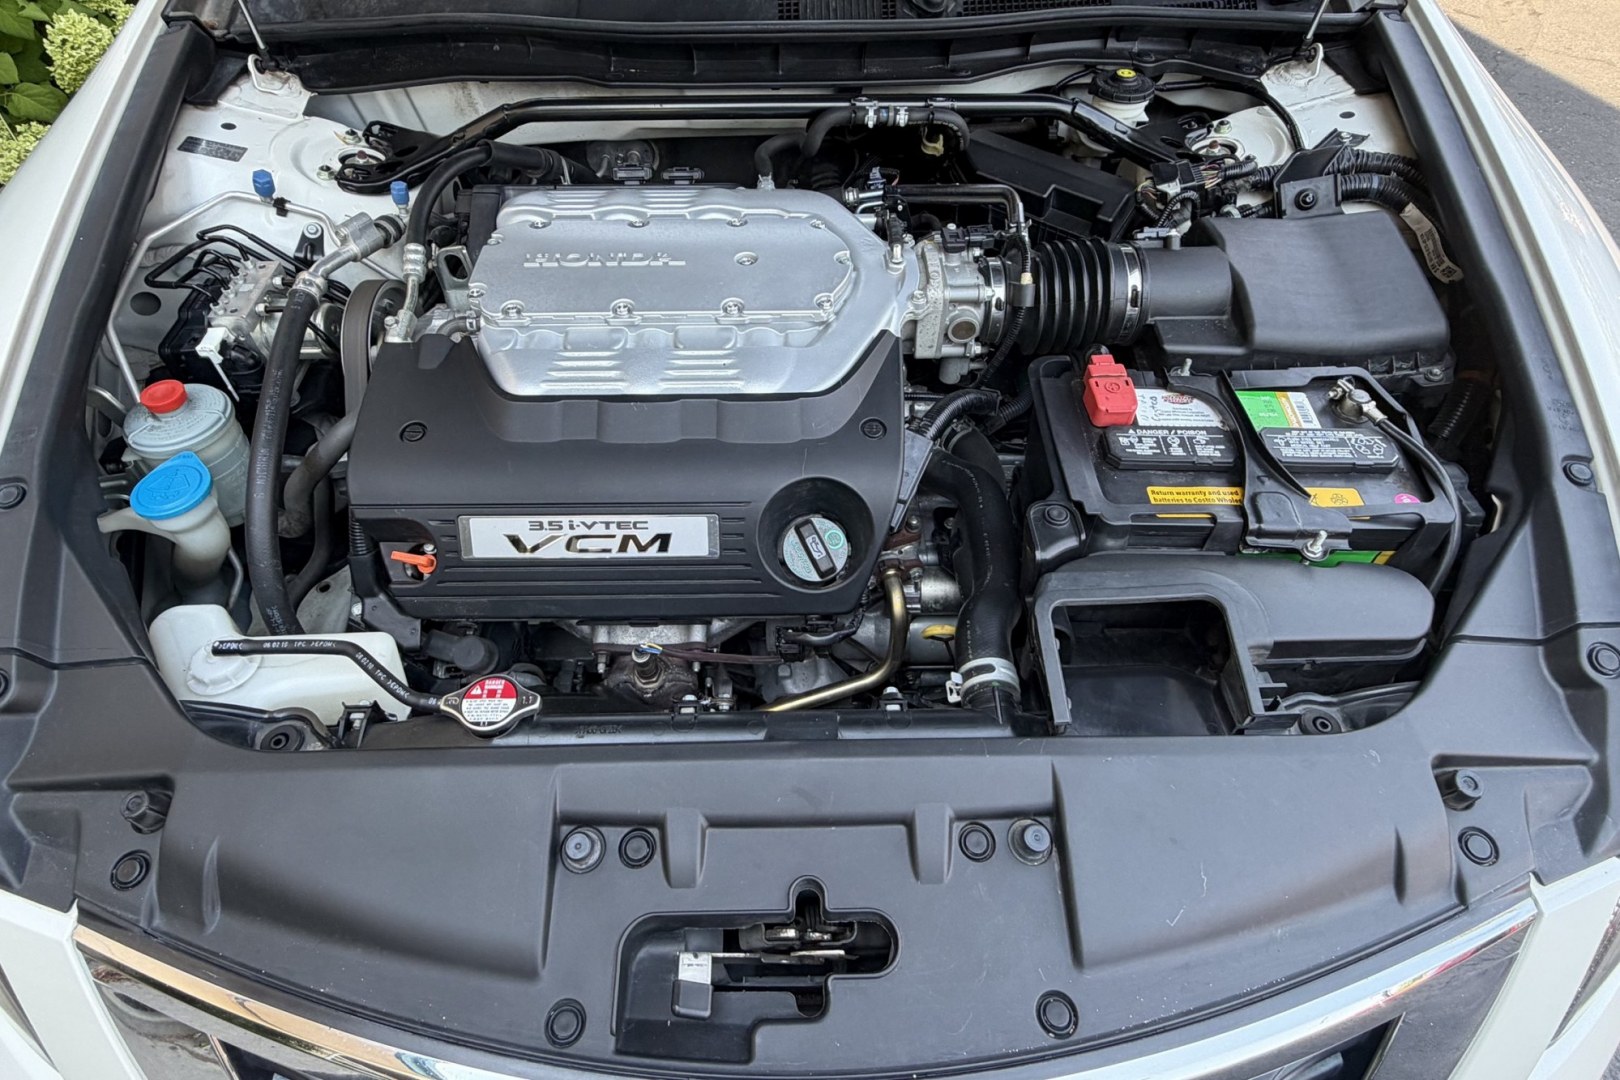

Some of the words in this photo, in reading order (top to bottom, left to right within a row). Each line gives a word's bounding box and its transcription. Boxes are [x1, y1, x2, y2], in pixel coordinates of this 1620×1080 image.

[523, 252, 686, 268] HONDA
[528, 520, 563, 531] 3.5
[568, 520, 649, 531] i-VTEC
[502, 533, 673, 554] VCM
